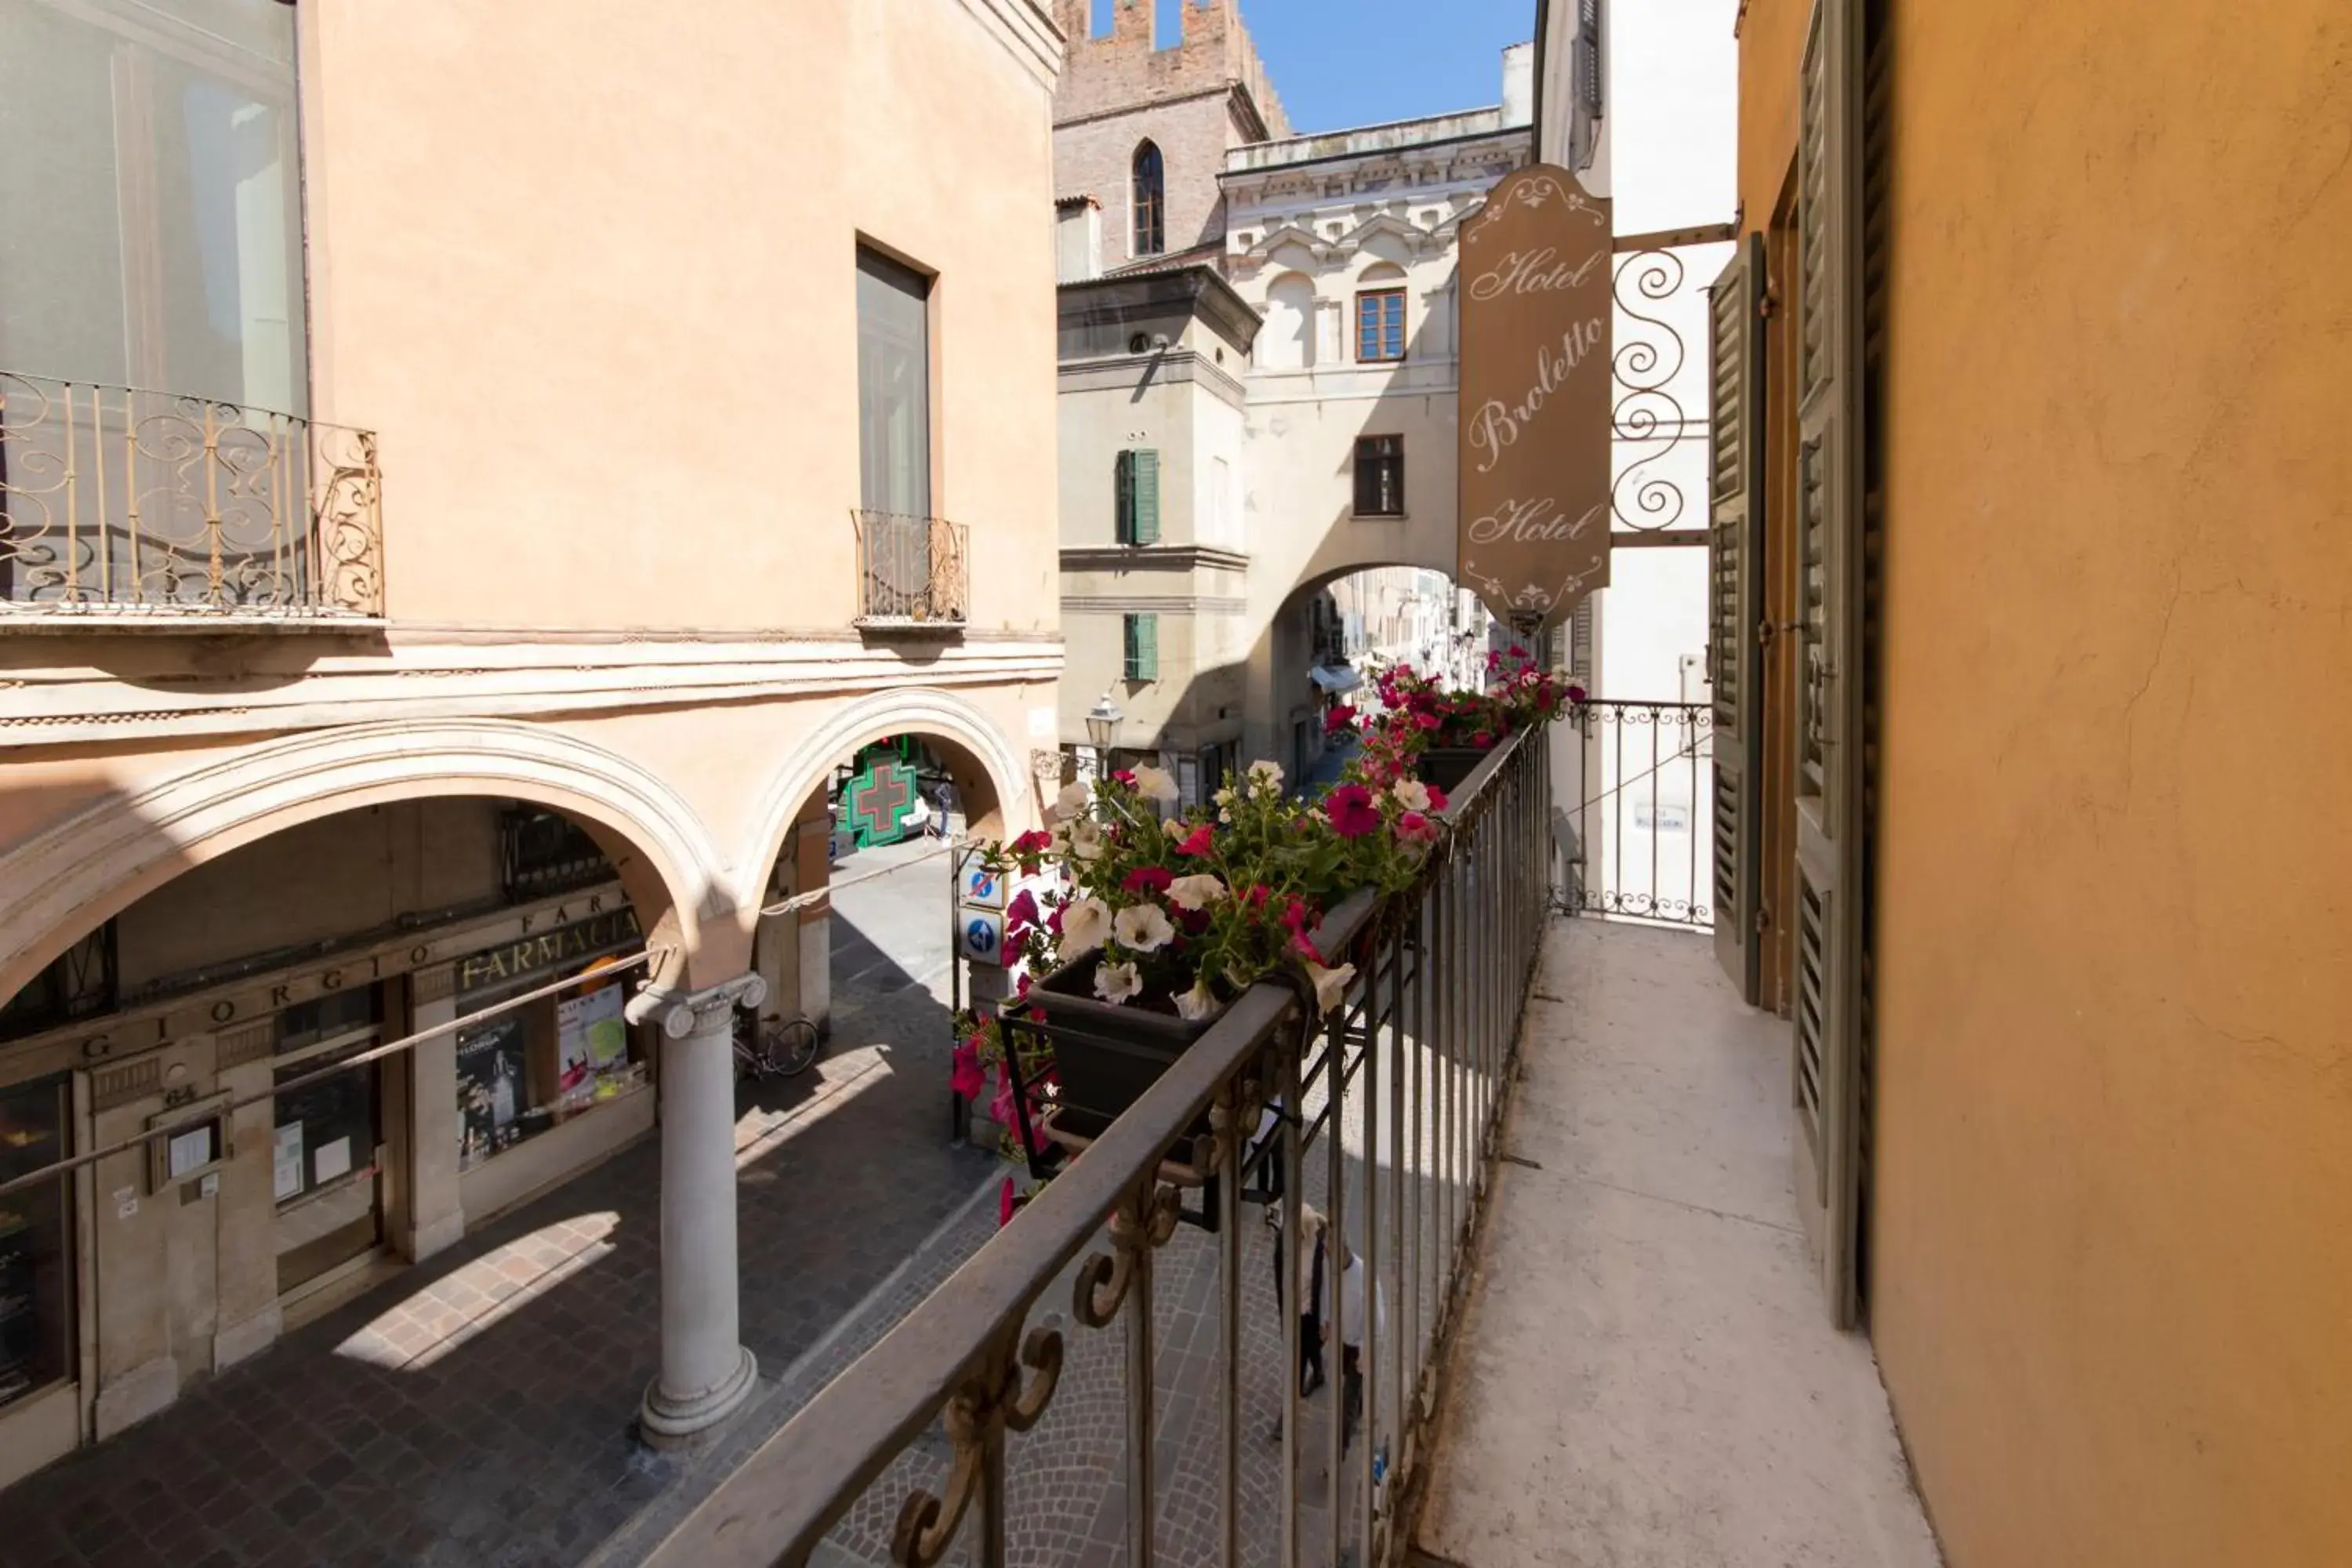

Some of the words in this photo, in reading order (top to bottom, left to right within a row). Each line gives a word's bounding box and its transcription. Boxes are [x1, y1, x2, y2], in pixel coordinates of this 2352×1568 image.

[1470, 247, 1605, 301] Hotel
[1468, 317, 1605, 472] Broletto
[1468, 496, 1605, 544] Hotel
[463, 909, 640, 989] FARMACIA
[81, 945, 428, 1058] GIORGIO
